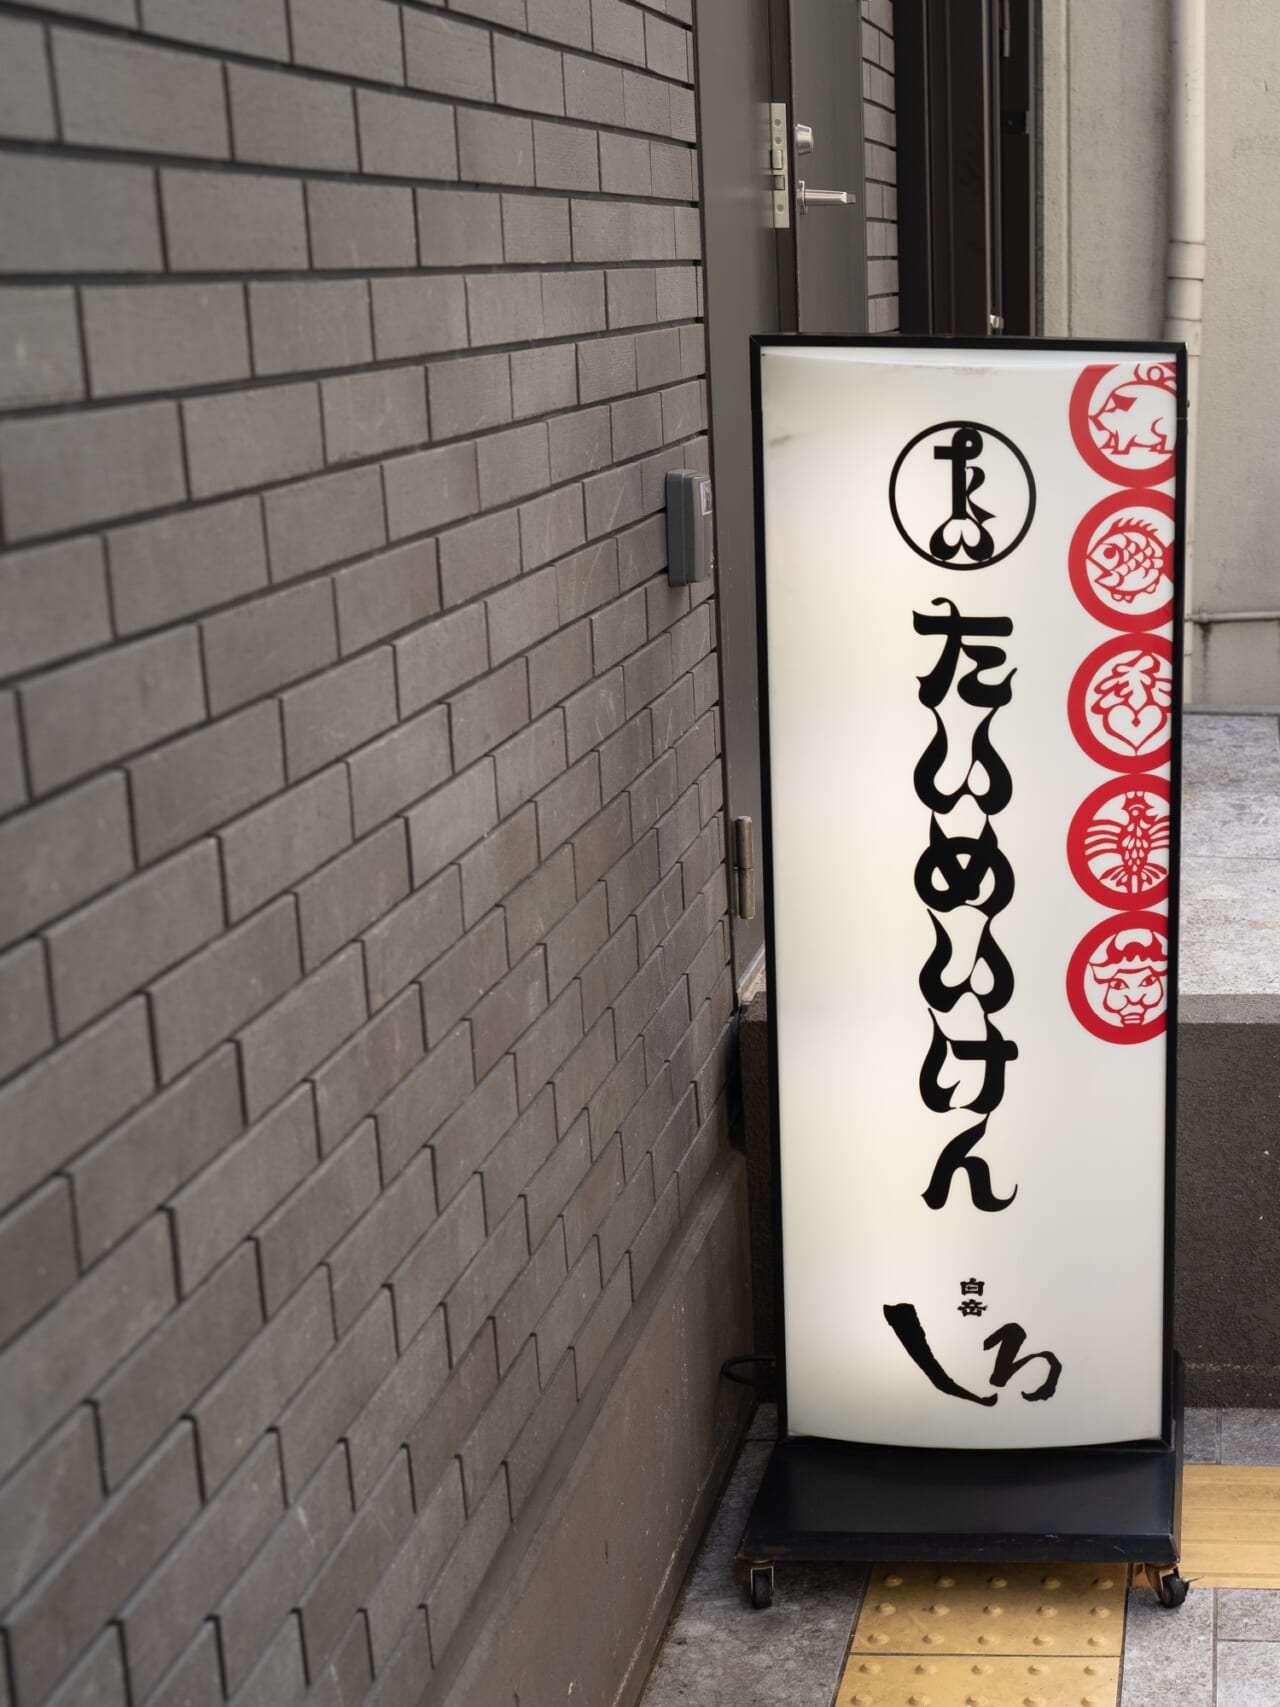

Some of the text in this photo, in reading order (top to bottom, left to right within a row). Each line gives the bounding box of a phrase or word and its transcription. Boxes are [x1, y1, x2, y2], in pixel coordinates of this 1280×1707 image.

[912, 597, 1019, 1213] たいめいけん
[957, 1277, 988, 1317] 白岳
[882, 1302, 1063, 1407] しろ
